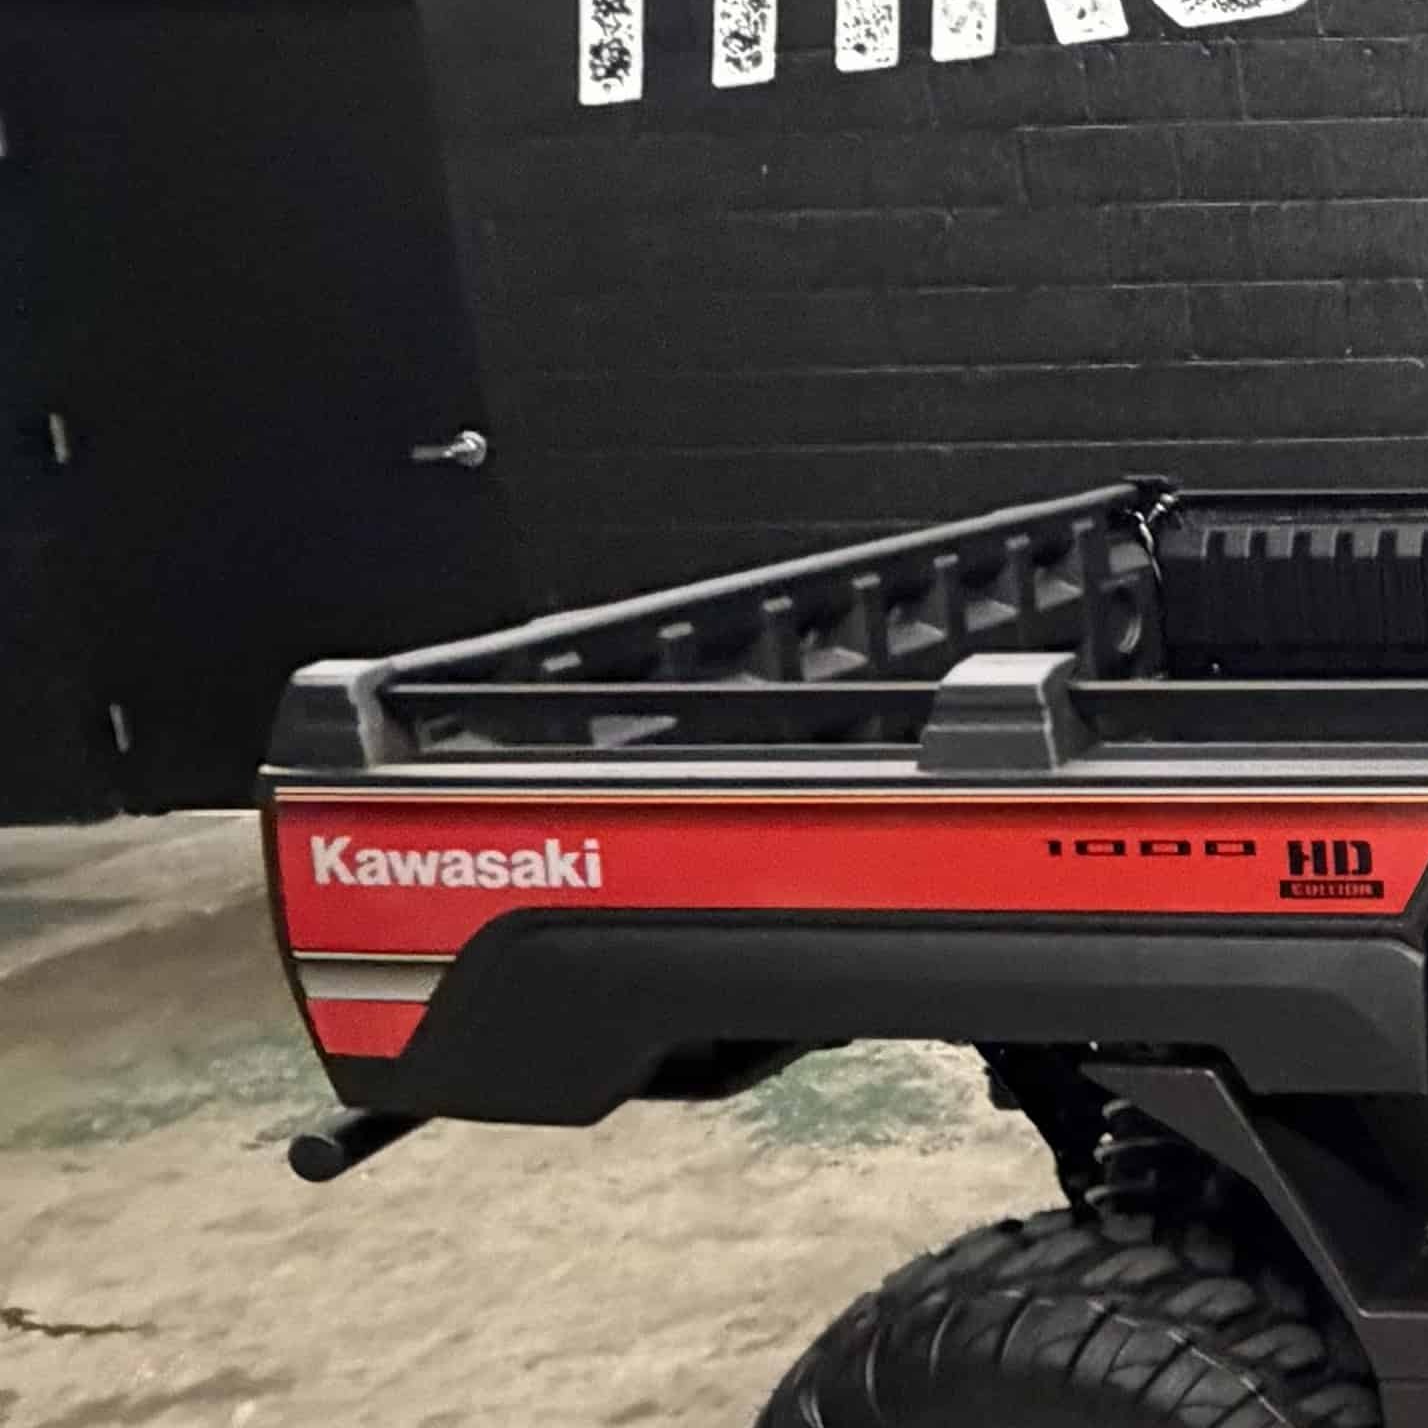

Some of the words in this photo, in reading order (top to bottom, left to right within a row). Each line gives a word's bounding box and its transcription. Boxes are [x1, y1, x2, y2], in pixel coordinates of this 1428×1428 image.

[311, 836, 602, 889] Kawasaki
[1047, 839, 1257, 856] 1000
[1287, 840, 1373, 876] HD
